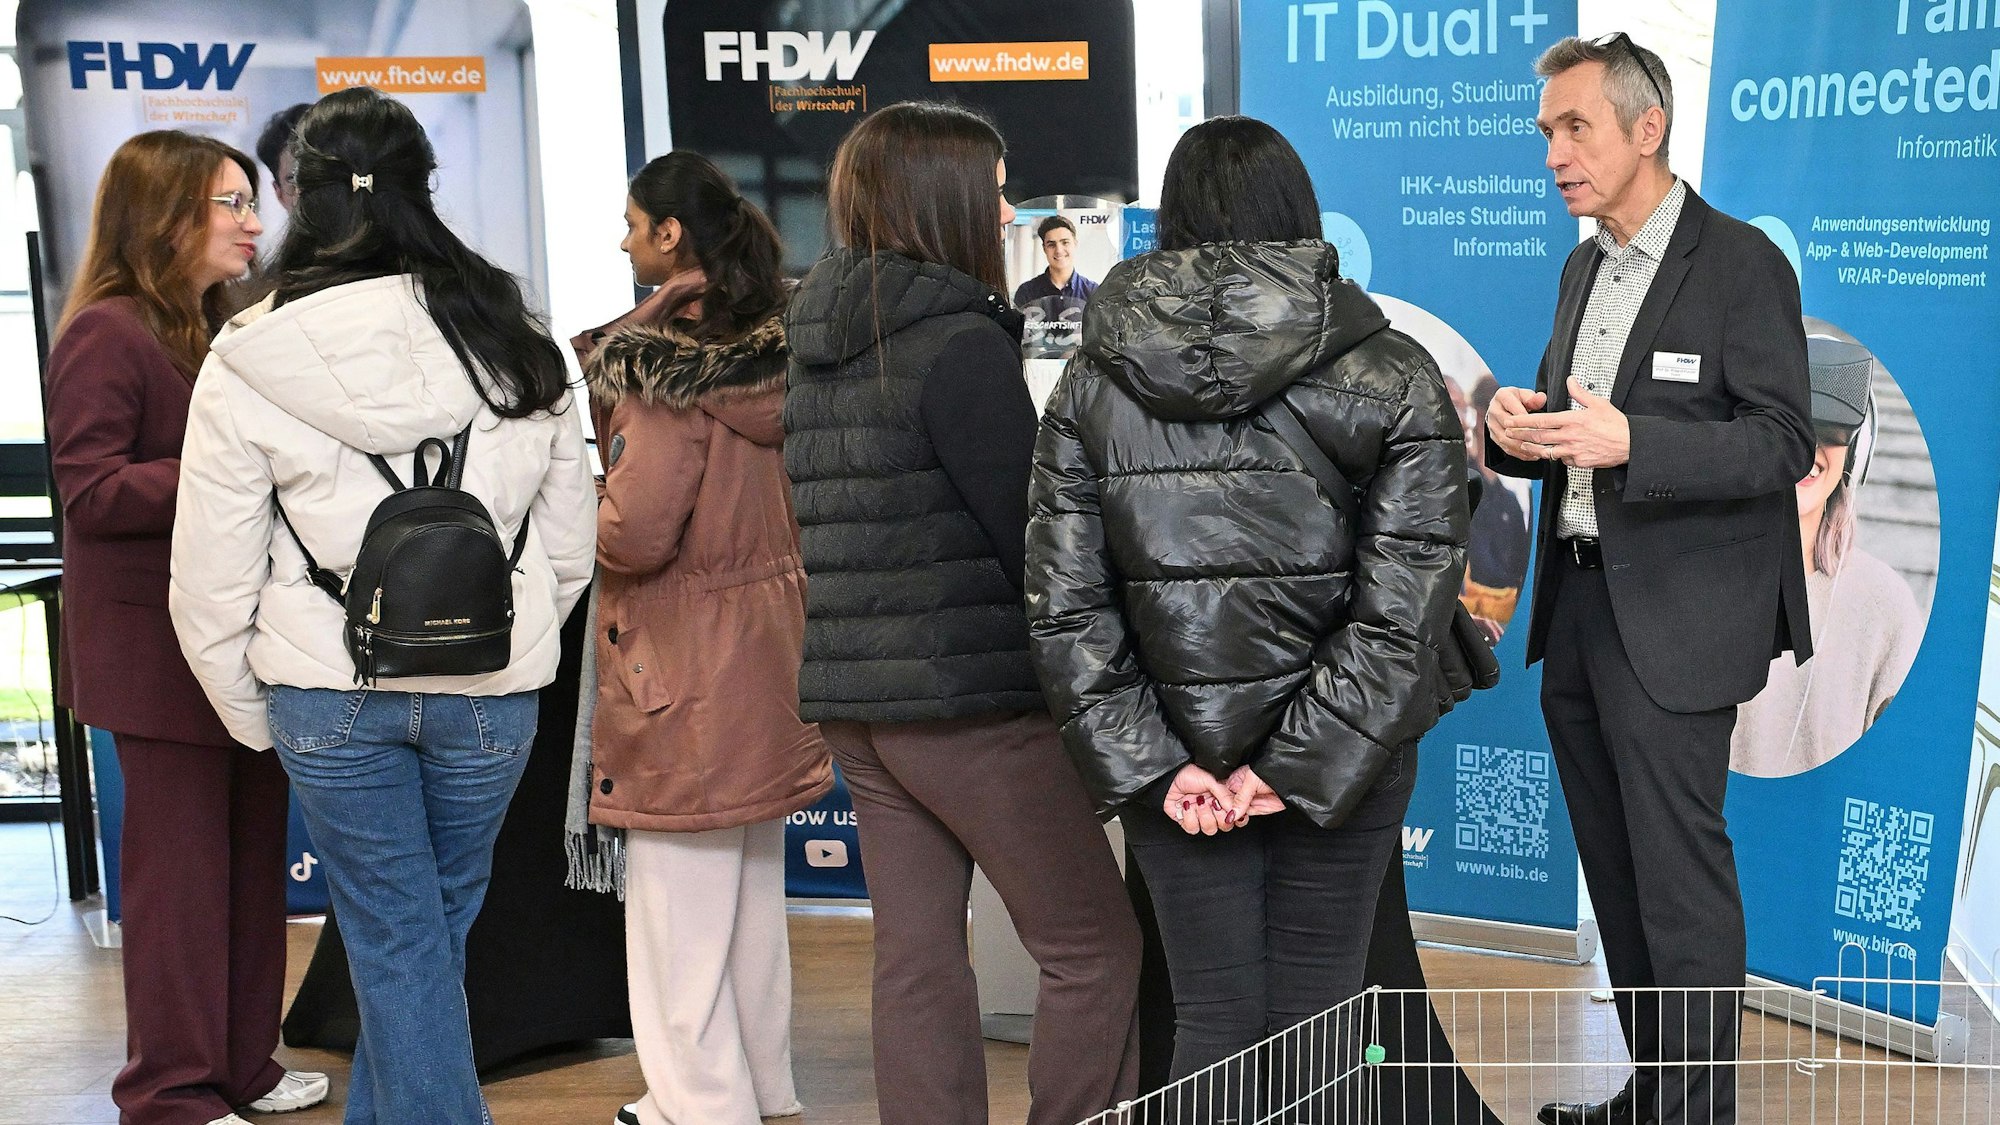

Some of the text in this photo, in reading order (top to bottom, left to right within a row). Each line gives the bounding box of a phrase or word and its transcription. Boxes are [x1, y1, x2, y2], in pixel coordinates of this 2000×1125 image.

[1287, 2, 1338, 63] IT
[67, 41, 256, 90] FHDW
[703, 30, 877, 81] FHDW
[934, 52, 1084, 73] www.fhdw.de
[321, 65, 481, 85] www.fhdw.de
[1730, 49, 2000, 122] connected
[149, 96, 247, 107] Fachhochschule
[774, 84, 861, 97] Fachhochschule
[1326, 78, 1547, 110] Ausbildung, Studium?
[149, 111, 238, 123] der Wirtschaft
[775, 100, 855, 113] der Wirtschaft
[1332, 113, 1543, 139] Warum nicht beides
[1897, 133, 1998, 159] Informatik
[1401, 174, 1546, 198] IHK-Ausbildung
[1080, 215, 1110, 225] FHDW
[1402, 205, 1547, 225] Duales Studium
[1811, 215, 1991, 236] Anwendungsentwicklung
[1453, 237, 1547, 256] Informatik
[1806, 241, 1989, 263] App- & Web-Development
[1838, 267, 1987, 290] VR/AR-Development
[424, 619, 452, 627] MICHAEL
[1456, 860, 1549, 883] www.bib.de
[1833, 928, 1917, 960] www.bib.de
